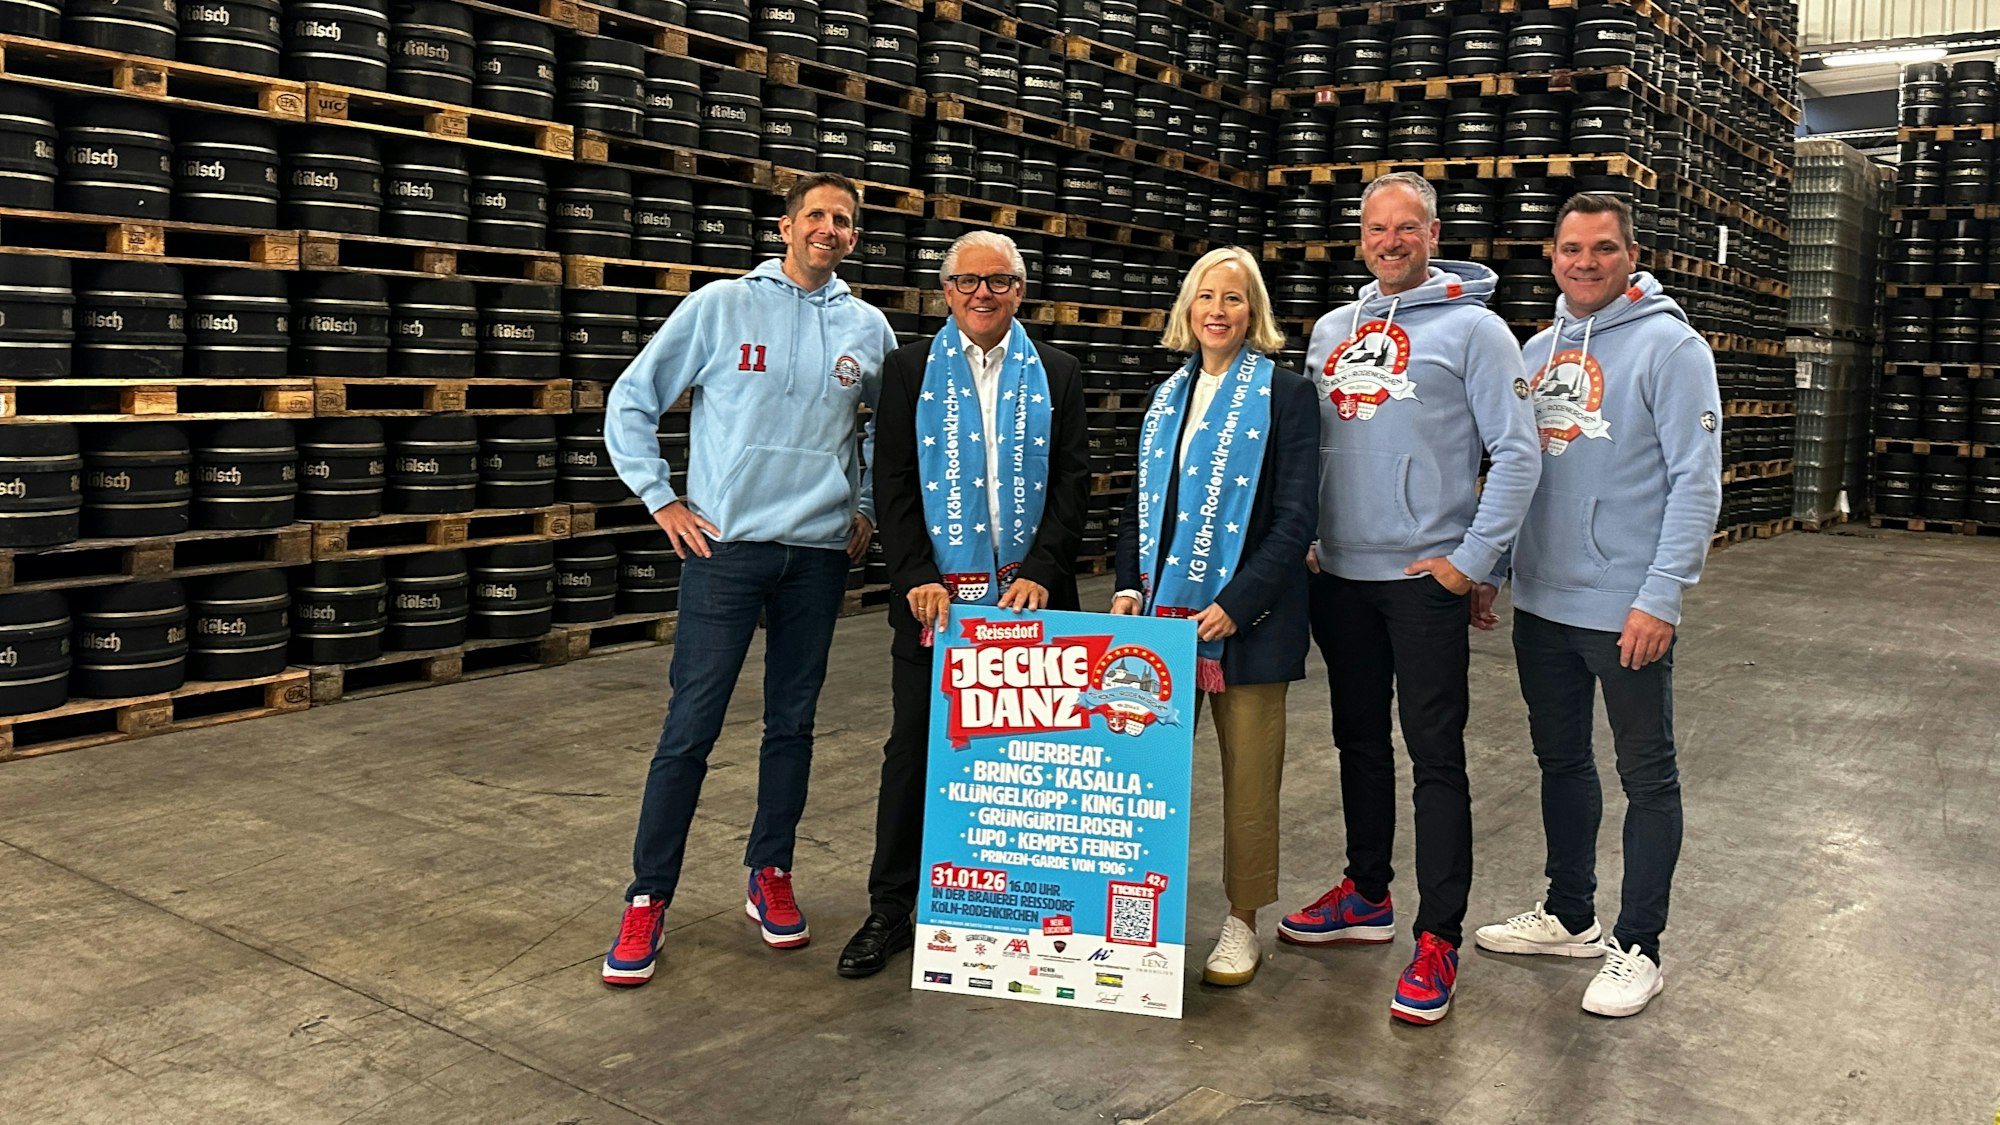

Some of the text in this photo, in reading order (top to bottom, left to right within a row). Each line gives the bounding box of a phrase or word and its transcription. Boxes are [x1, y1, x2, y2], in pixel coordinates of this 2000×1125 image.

[761, 7, 796, 23] Kölsch
[404, 39, 449, 62] Kölsch
[711, 105, 746, 122] Kölsch
[634, 211, 671, 228] Kölsch
[310, 316, 358, 336] Kölsch
[492, 323, 536, 342] Kölsch
[738, 343, 767, 372] 11
[1230, 384, 1249, 408] von
[396, 456, 439, 476] Kölsch
[1013, 445, 1026, 472] von
[1139, 458, 1149, 487] von
[1192, 411, 1240, 557] Köln-Rodenkirchen
[1013, 477, 1026, 514] 2014
[1138, 491, 1150, 529] 2014
[948, 523, 963, 546] KG
[1187, 559, 1208, 583] KG
[396, 593, 441, 610] Kölsch
[476, 582, 518, 600] Kölsch
[199, 617, 247, 637] Kölsch
[975, 623, 1040, 641] Reissdorf
[951, 645, 1089, 688] JECKE
[960, 688, 1082, 728] DANZ
[1007, 740, 1105, 768] QUERBEAT
[973, 760, 1142, 795] BRINGS KASALLA
[948, 782, 1166, 821] KLÜNGELKÖPP KING LOUI
[978, 806, 1133, 838] GRÜNGÜRTELROSEN
[967, 827, 1142, 861] LUPO KEMPES FEINEST
[980, 849, 1126, 876] PRINZEN-GARDE VON 1906
[932, 866, 1061, 896] 31.01.26 16.00 UHR
[1111, 884, 1155, 898] TICKETS
[931, 887, 1075, 912] IN DER BRAUEREI REISSDORF
[931, 900, 1039, 922] KÖLN-RODENKIRCHEN
[1003, 938, 1031, 954] AXA
[1141, 958, 1169, 969] LENZ
